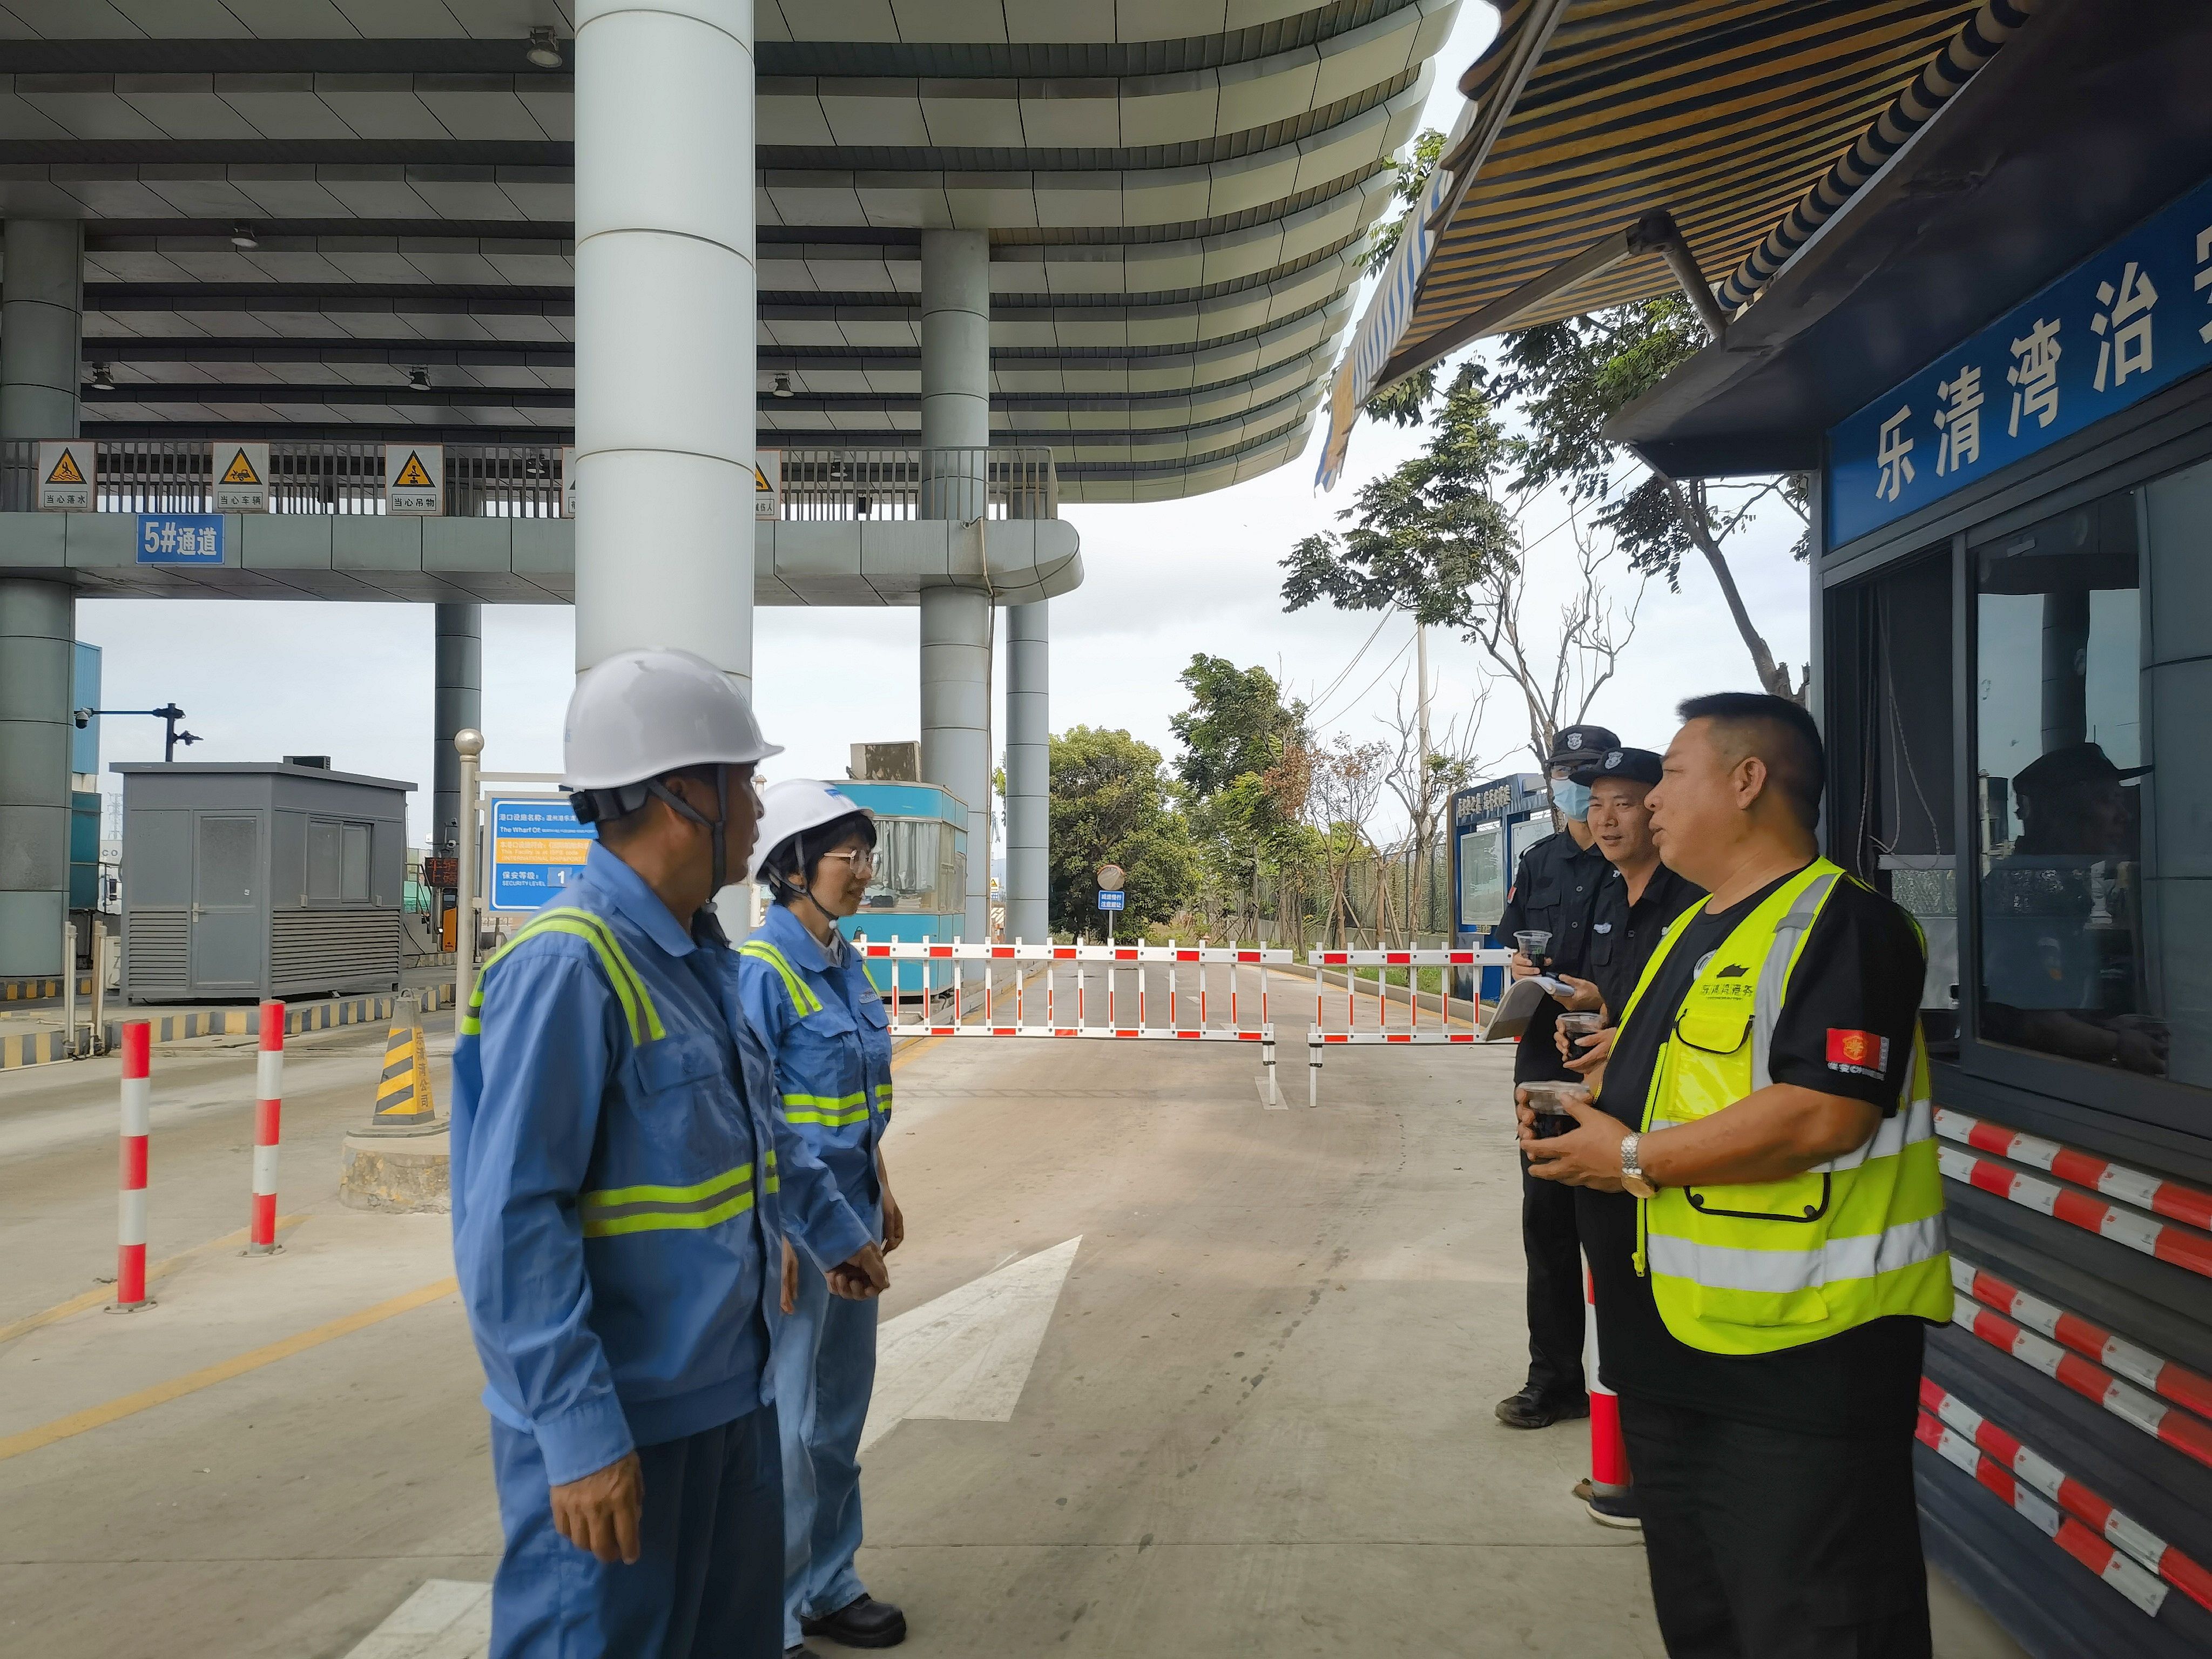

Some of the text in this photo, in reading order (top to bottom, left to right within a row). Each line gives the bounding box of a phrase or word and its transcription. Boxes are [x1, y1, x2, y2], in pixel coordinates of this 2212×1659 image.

[46, 495, 86, 504] 当心落水
[220, 496, 261, 505] 当心车辆
[394, 498, 435, 507] 当心吊物
[145, 522, 217, 556] 5#通道
[557, 871, 565, 884] 1
[416, 1031, 429, 1107] 乐清湾公司
